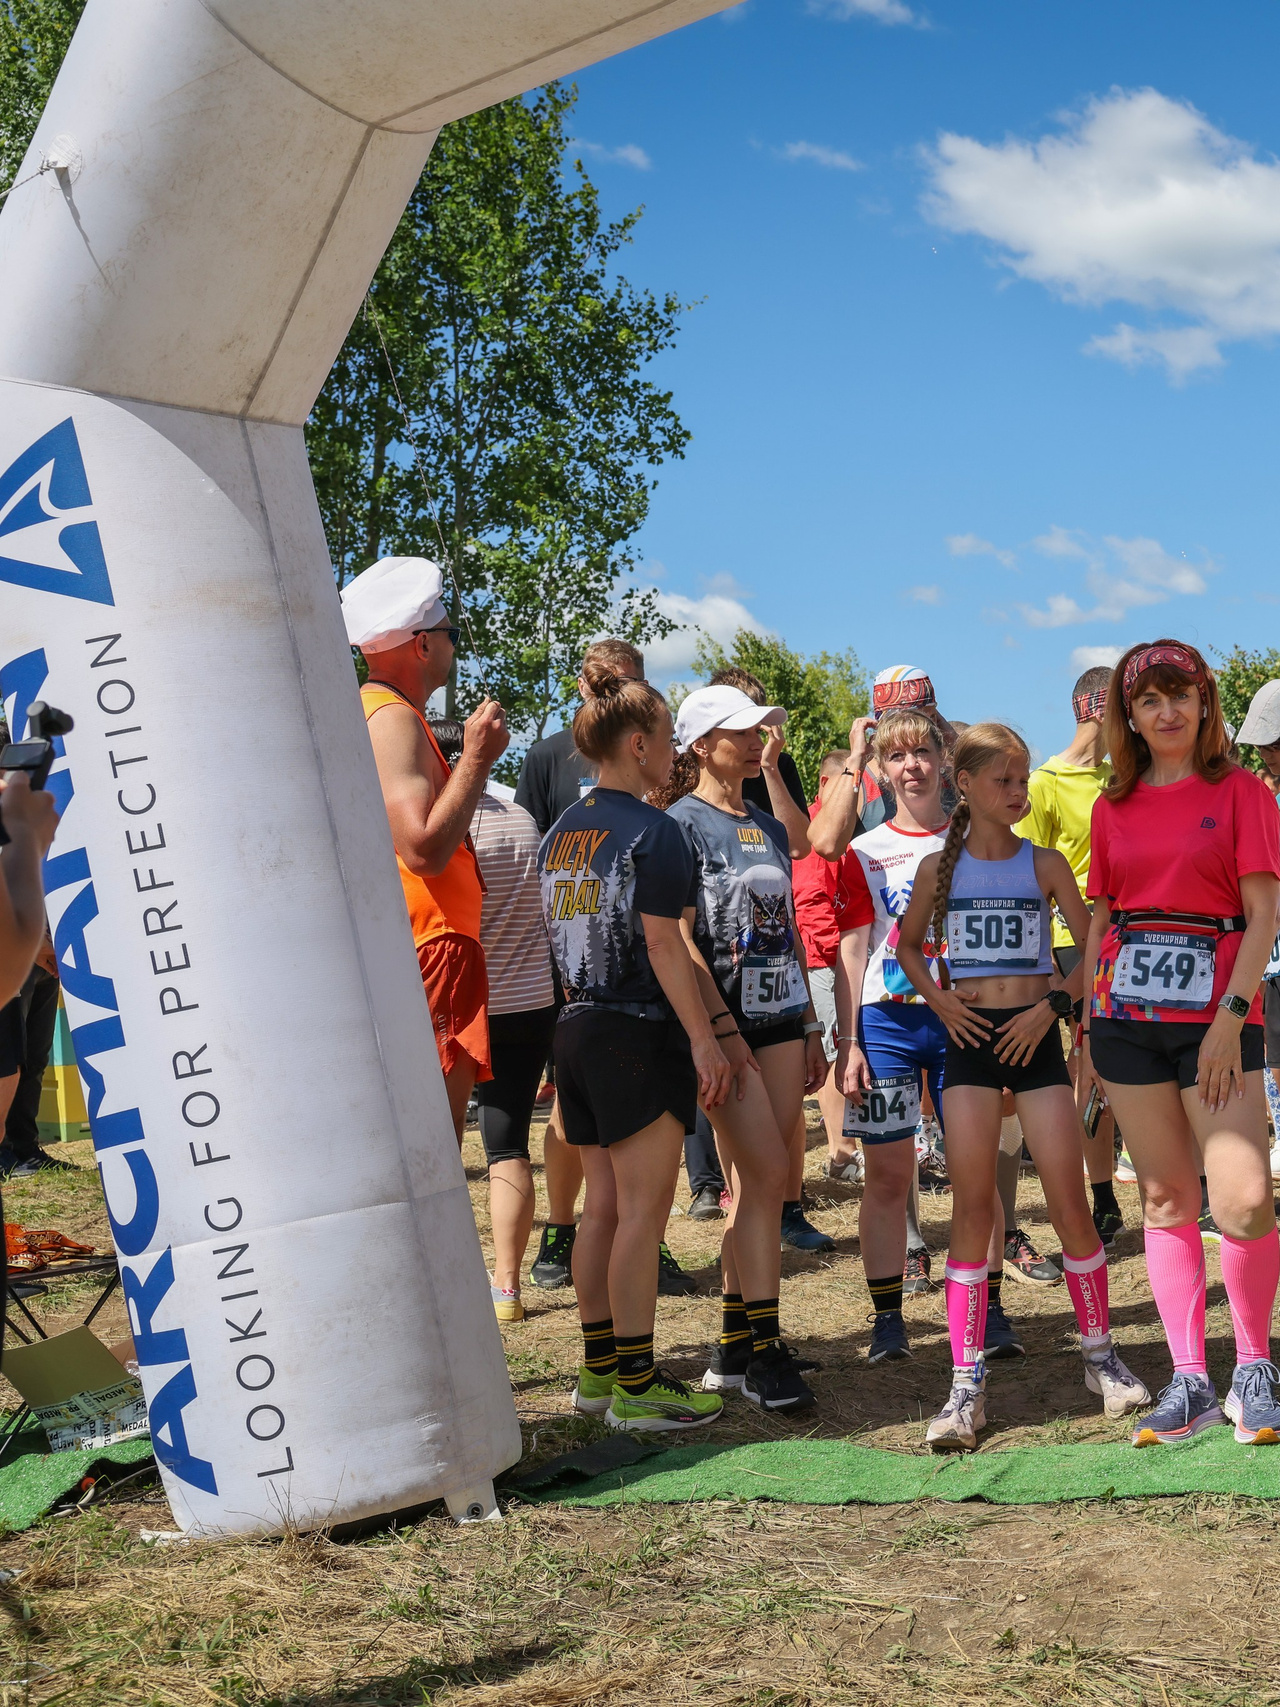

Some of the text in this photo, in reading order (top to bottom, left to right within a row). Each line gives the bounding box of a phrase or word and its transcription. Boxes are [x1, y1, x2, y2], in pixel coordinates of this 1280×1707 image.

[545, 828, 612, 878] LUCKY
[737, 828, 764, 845] LUCKY
[868, 851, 914, 866] МИНИНСКИЙ
[869, 859, 906, 872] МАРАФОН
[551, 879, 601, 921] TRAIL
[965, 914, 1023, 949] 503
[1130, 949, 1196, 990] 549
[85, 632, 295, 1479] LOOKING FOR PERFECTION
[858, 1090, 907, 1124] 504
